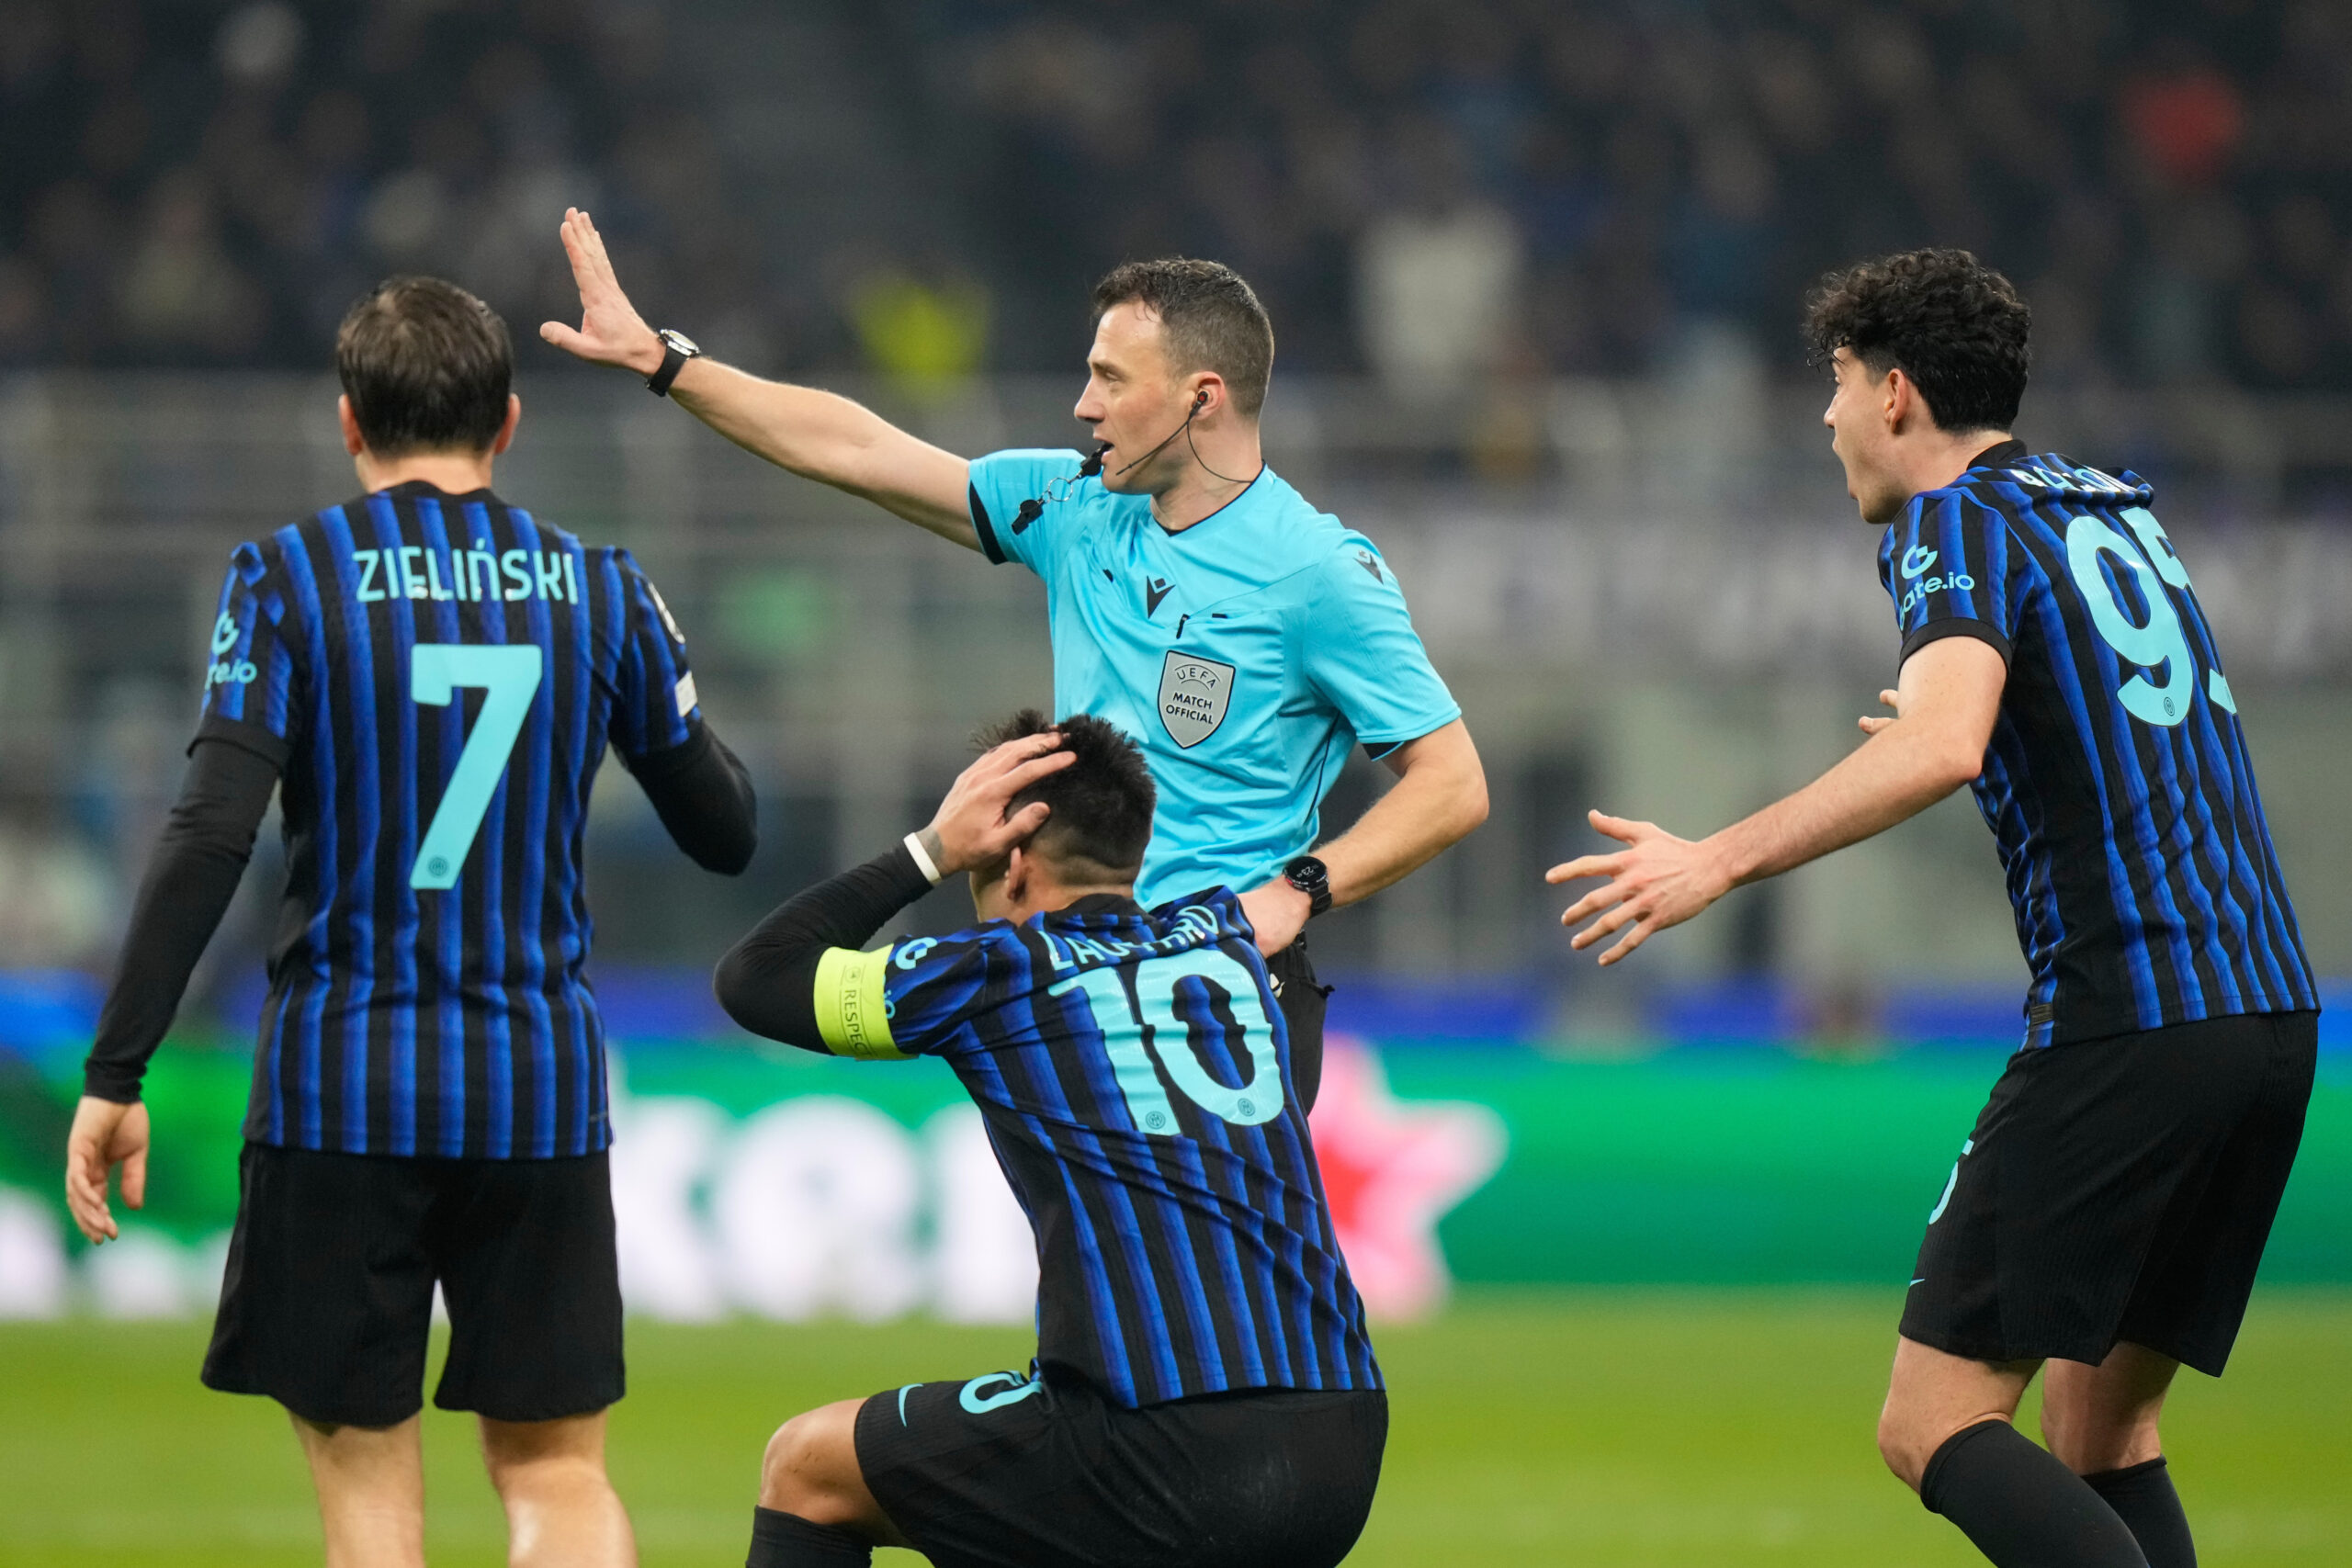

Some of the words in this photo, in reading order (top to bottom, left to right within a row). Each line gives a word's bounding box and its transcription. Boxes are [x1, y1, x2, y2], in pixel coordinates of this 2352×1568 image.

[352, 537, 579, 605] ZIELIŃSKI
[1176, 667, 1216, 689] UEFA
[1165, 704, 1214, 725] OFFICIAL
[1172, 692, 1213, 710] MATCH
[409, 643, 543, 890] 7
[1047, 949, 1285, 1137] 10
